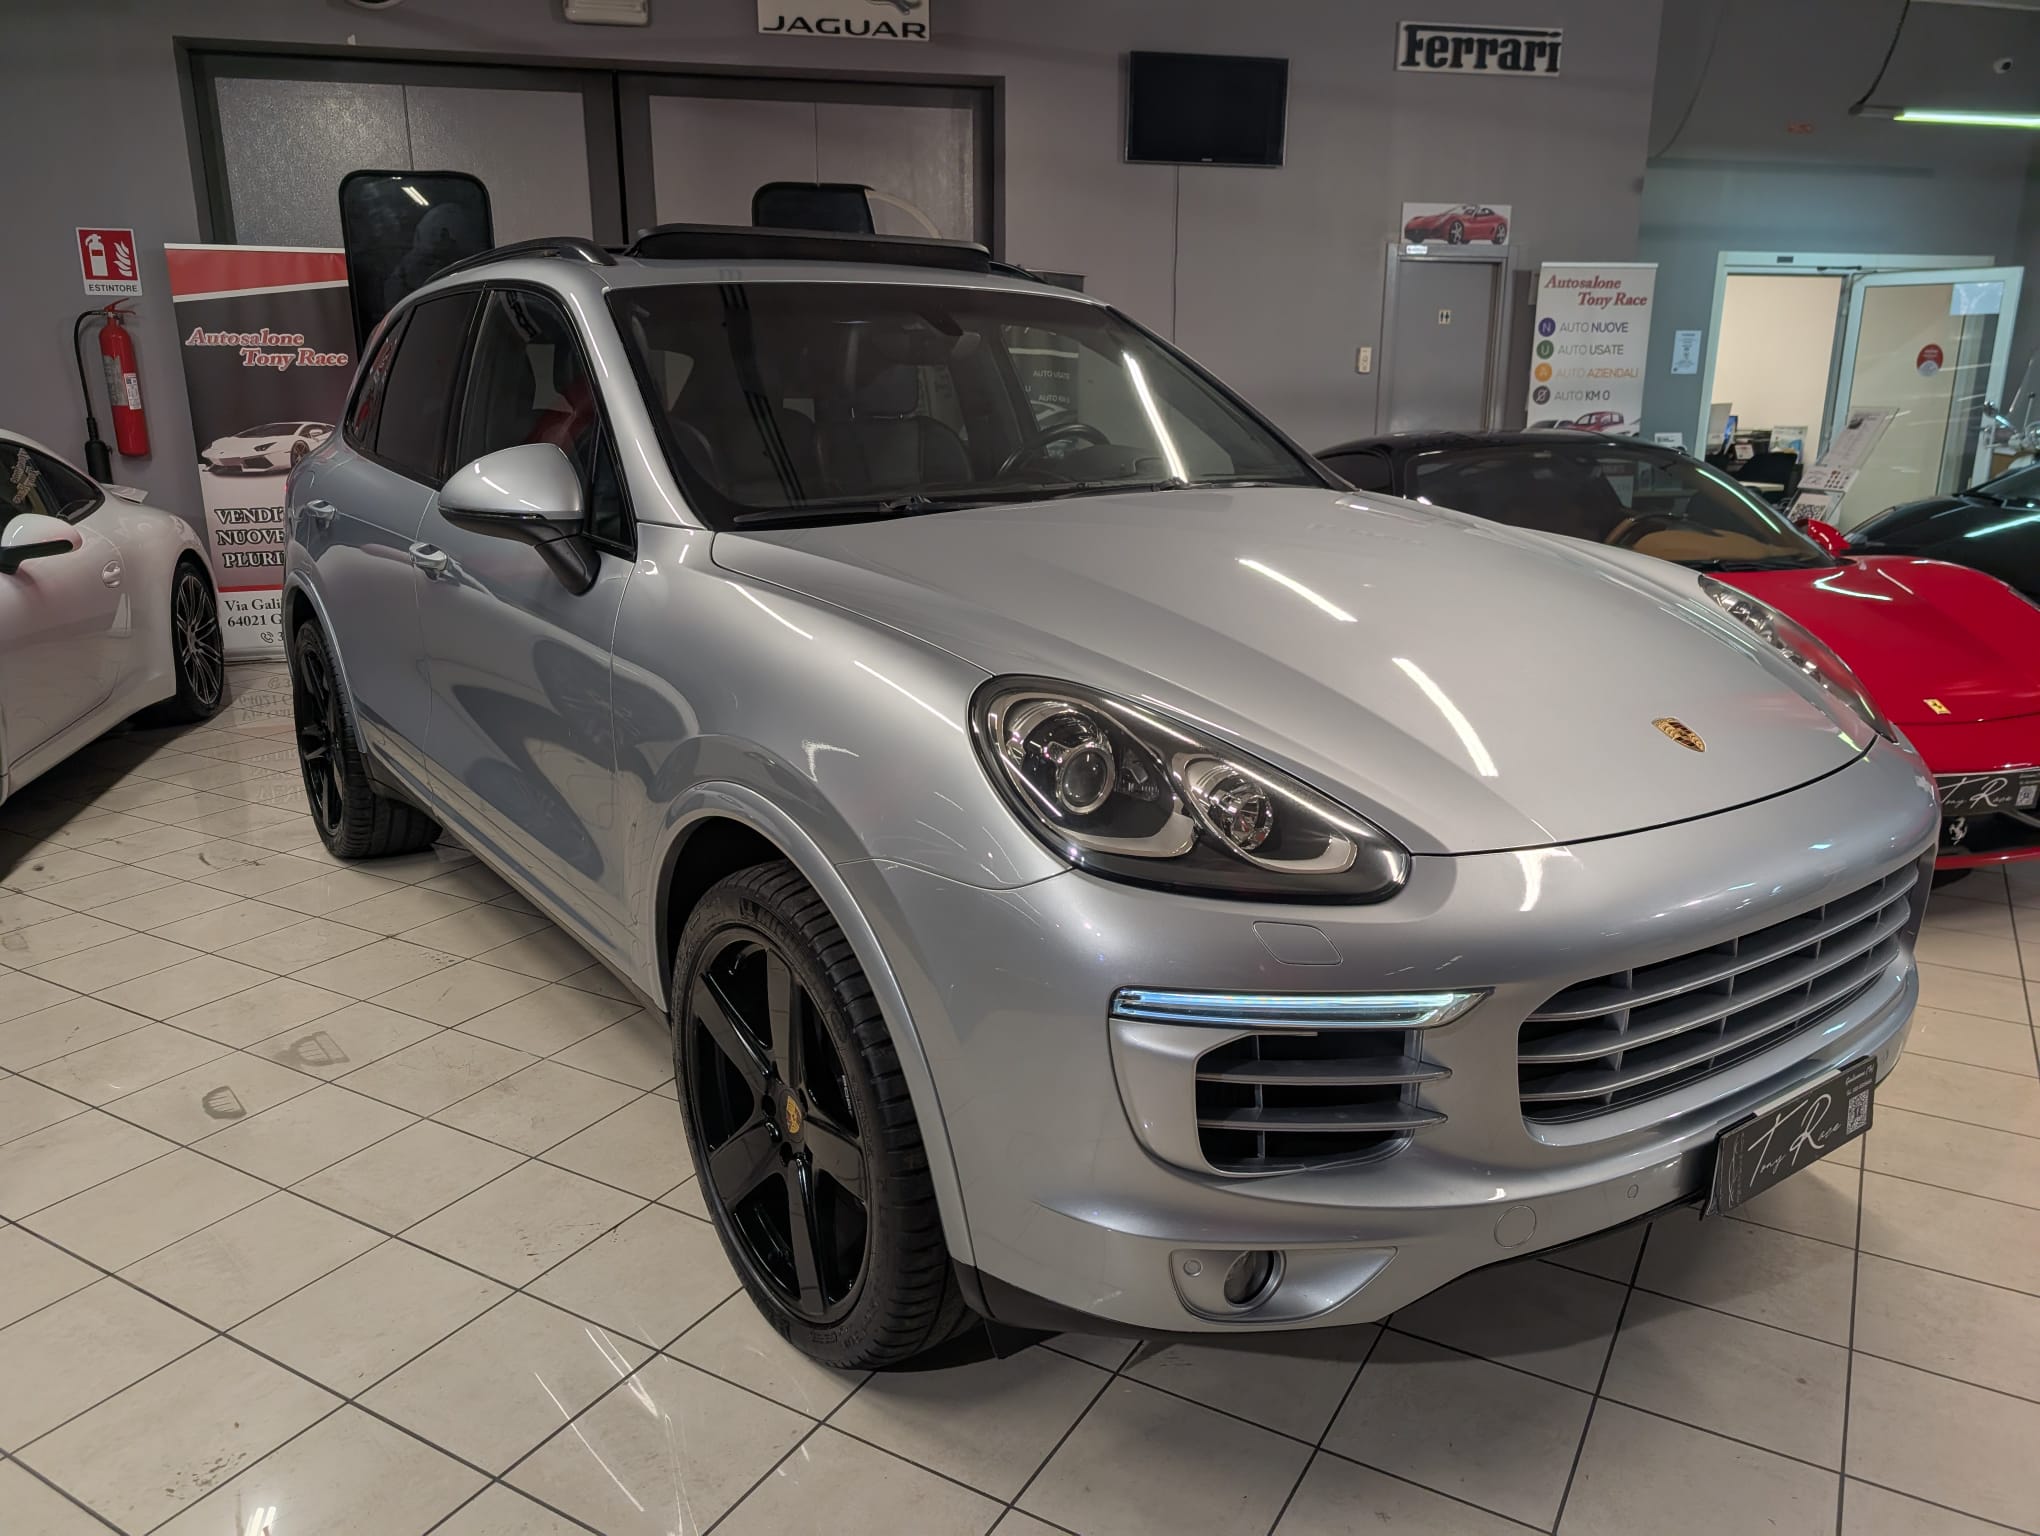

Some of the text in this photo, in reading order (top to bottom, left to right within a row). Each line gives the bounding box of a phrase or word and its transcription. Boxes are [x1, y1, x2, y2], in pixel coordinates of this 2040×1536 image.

[763, 15, 927, 39] JAGUAR
[1401, 24, 1562, 73] Ferrari
[1544, 274, 1621, 289] Autosalone
[88, 284, 138, 293] ESTINTORE
[1578, 291, 1648, 310] Tony Race
[1559, 322, 1629, 333] AUTO NUOVE
[185, 327, 304, 346] Autosalone
[1557, 344, 1624, 356] AUTO USATE
[240, 347, 349, 372] Tony Race
[1587, 367, 1639, 378] AZIENDALI
[1554, 391, 1584, 401] AUTO
[1585, 391, 1600, 401] KM
[224, 600, 249, 612] Via
[227, 615, 267, 628] 64021
